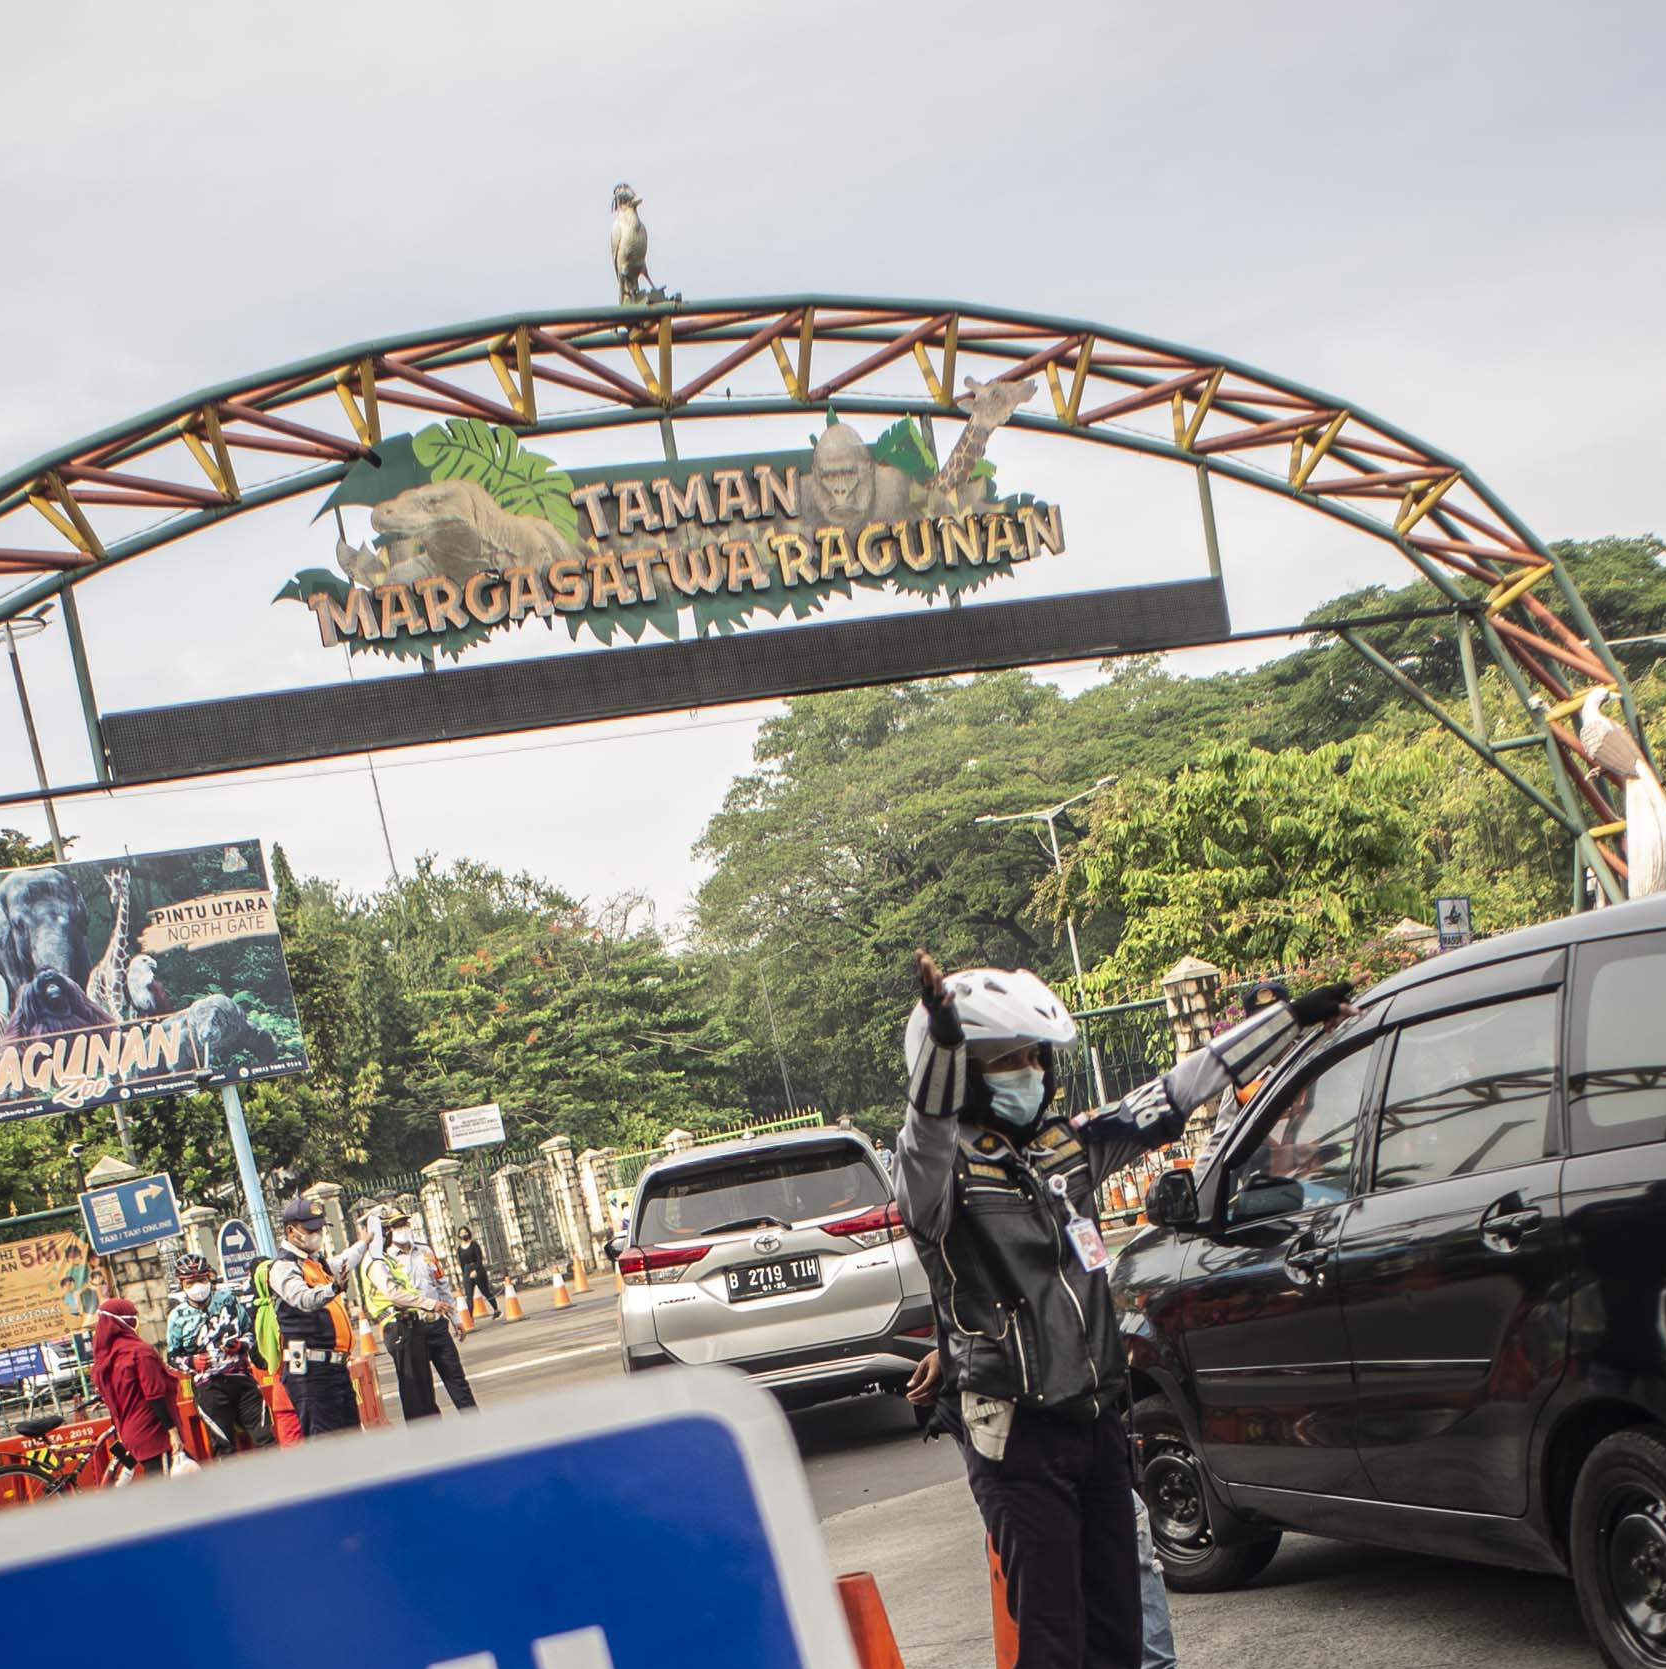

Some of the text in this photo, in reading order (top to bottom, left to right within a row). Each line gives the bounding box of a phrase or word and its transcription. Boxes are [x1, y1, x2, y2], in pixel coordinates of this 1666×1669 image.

[572, 465, 800, 542] TAMAN
[307, 505, 1066, 648] MARGASATWA RAGUNAN
[154, 896, 269, 925] PINTU UTARA
[168, 914, 265, 942] NORTH GATE
[99, 1233, 119, 1245] TAXI
[124, 1228, 142, 1239] TAXI
[142, 1219, 173, 1234] ONLINE
[17, 1240, 60, 1269] 5M
[728, 1258, 817, 1290] B 2719 TIH
[69, 1426, 94, 1439] 2019
